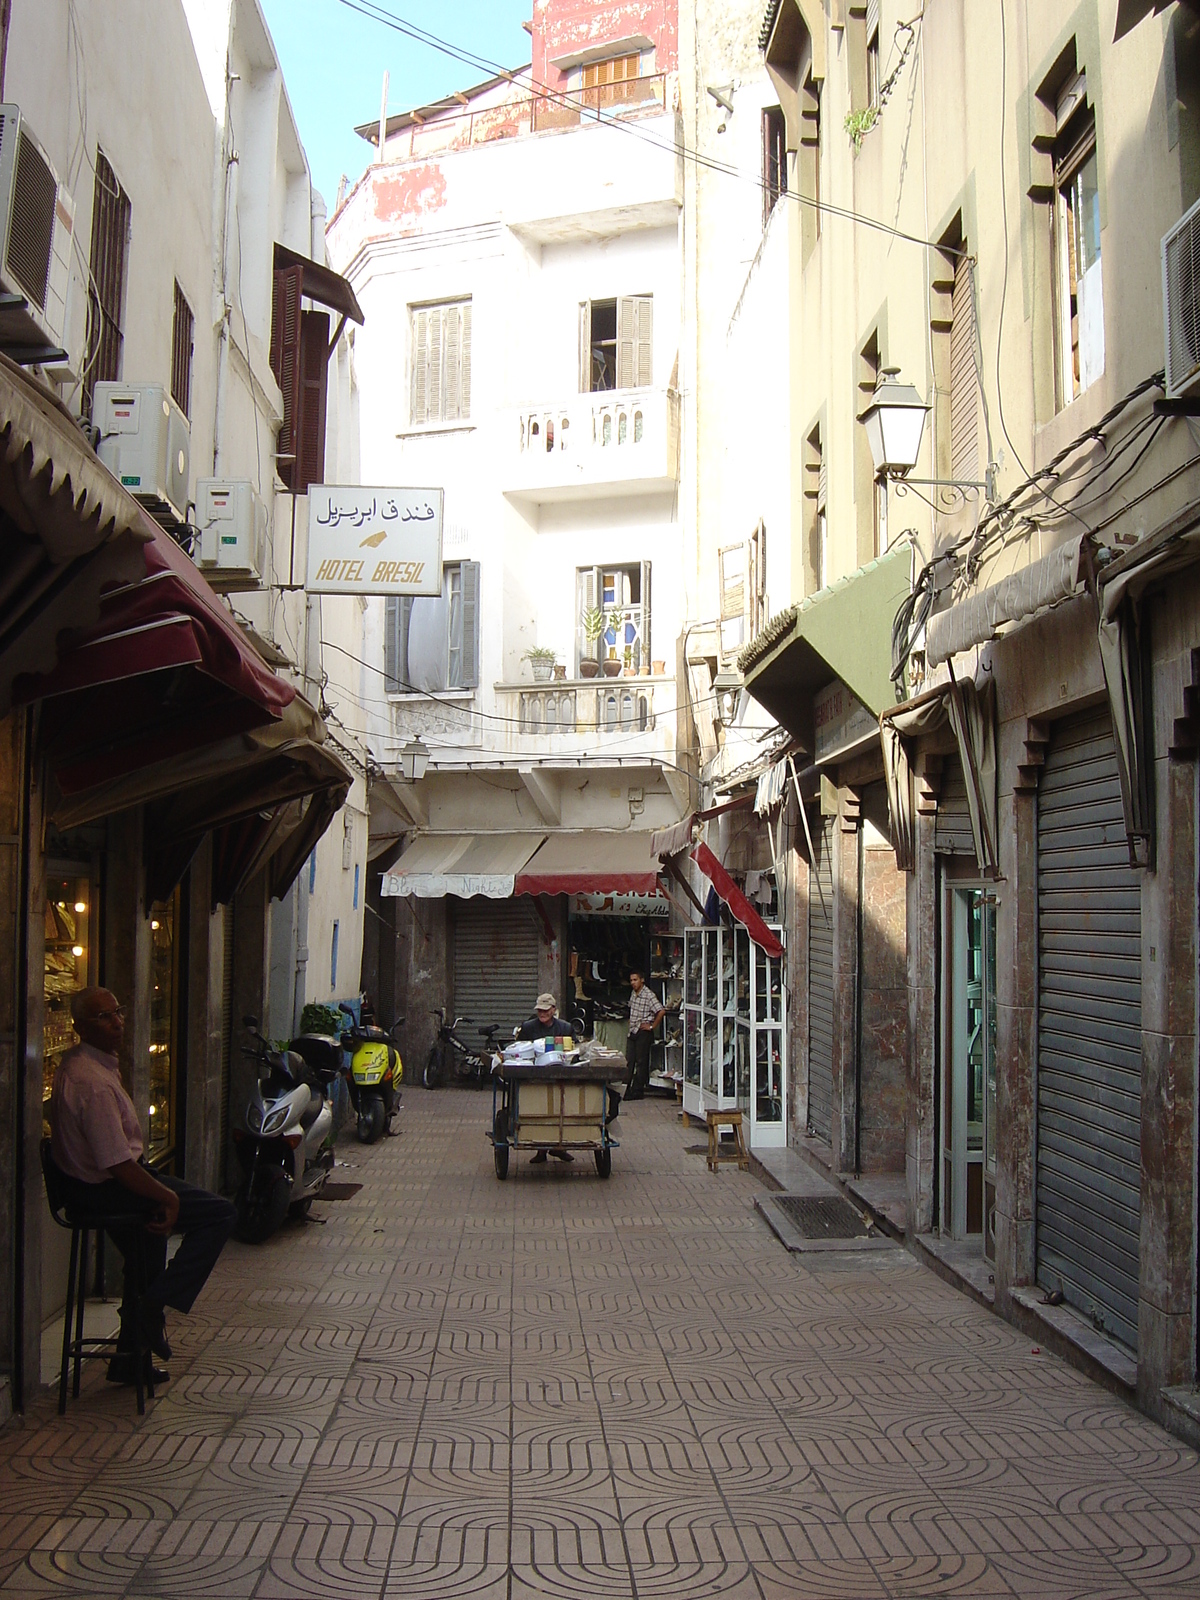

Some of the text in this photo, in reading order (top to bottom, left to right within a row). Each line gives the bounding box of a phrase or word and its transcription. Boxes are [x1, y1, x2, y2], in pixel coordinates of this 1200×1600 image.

[316, 497, 435, 527] فندق ابريزيل
[315, 559, 425, 584] HOTEL BRESIL
